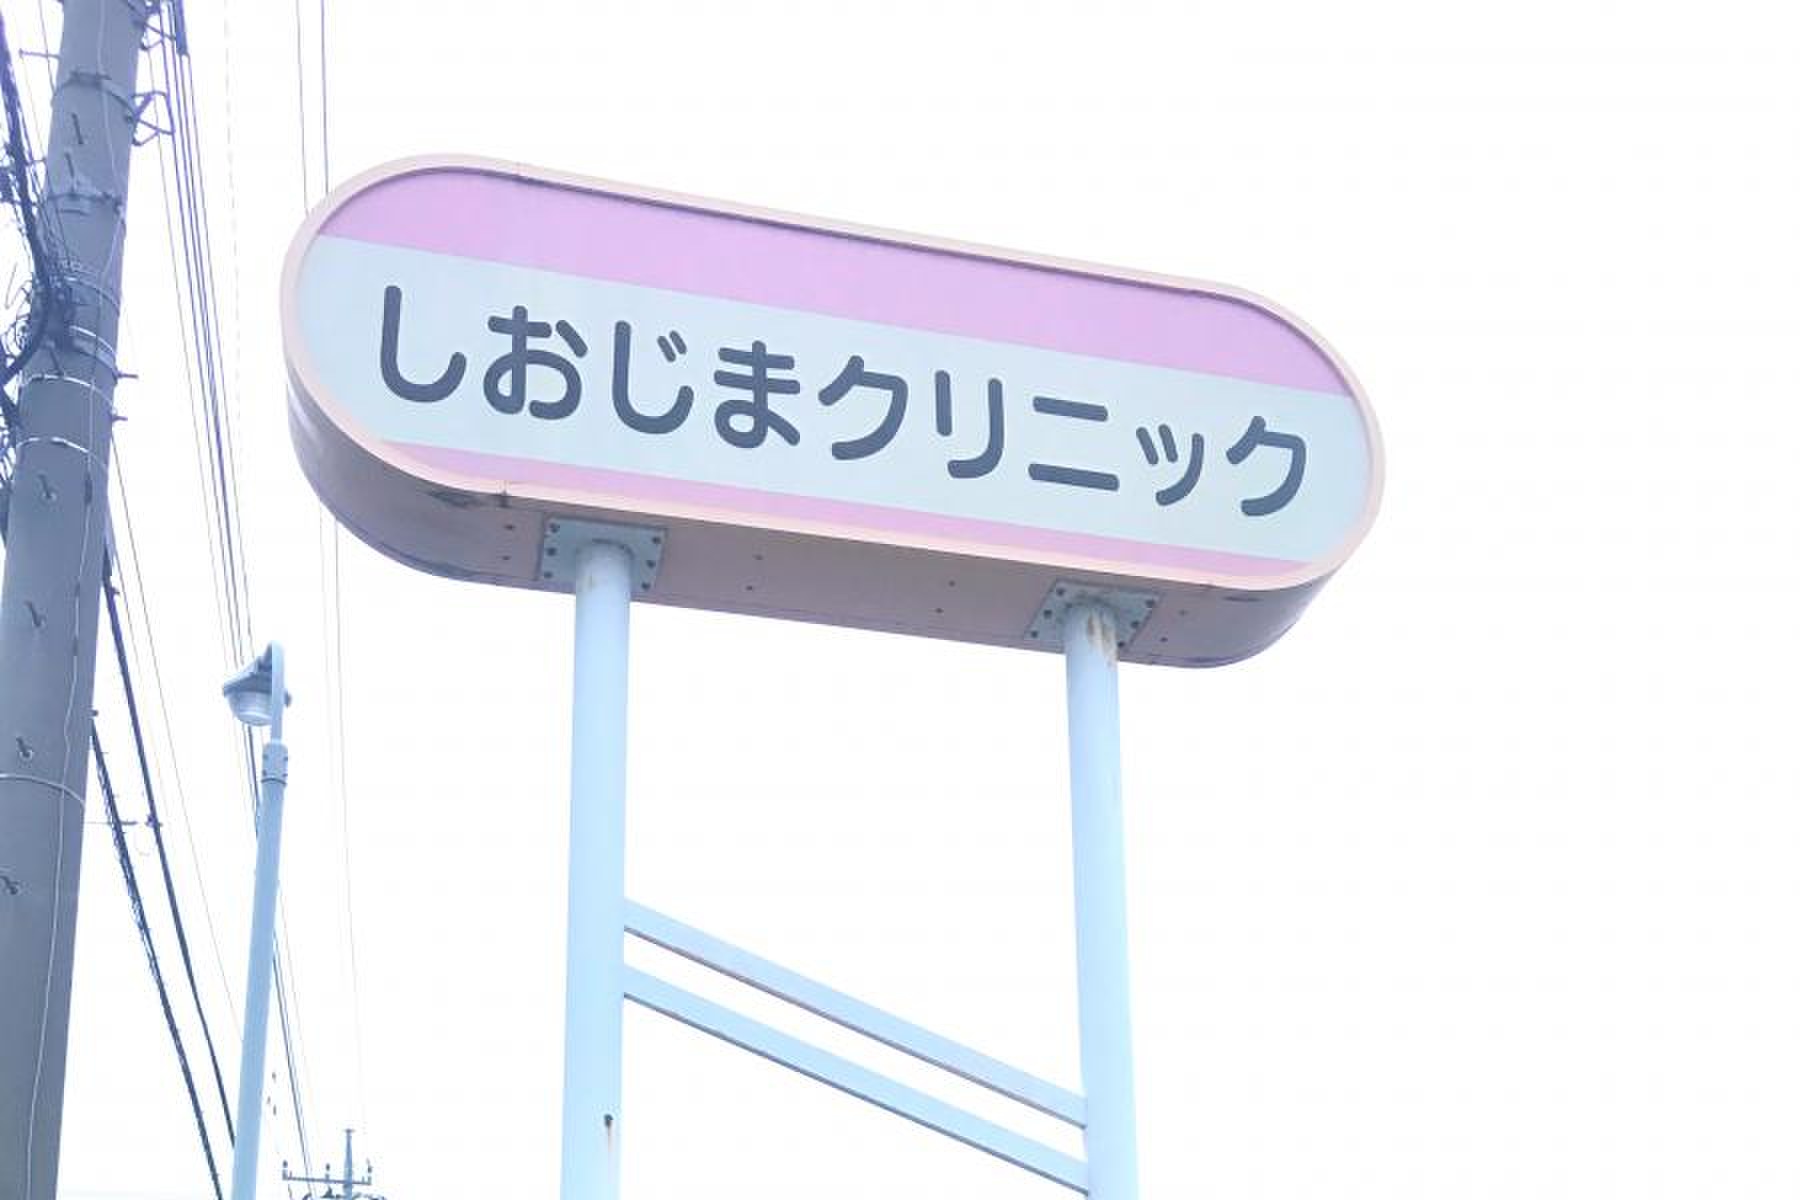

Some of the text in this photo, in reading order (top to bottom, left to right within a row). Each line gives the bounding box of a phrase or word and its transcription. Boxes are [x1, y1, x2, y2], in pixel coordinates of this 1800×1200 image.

[379, 285, 1307, 517] しおじまクリニック
